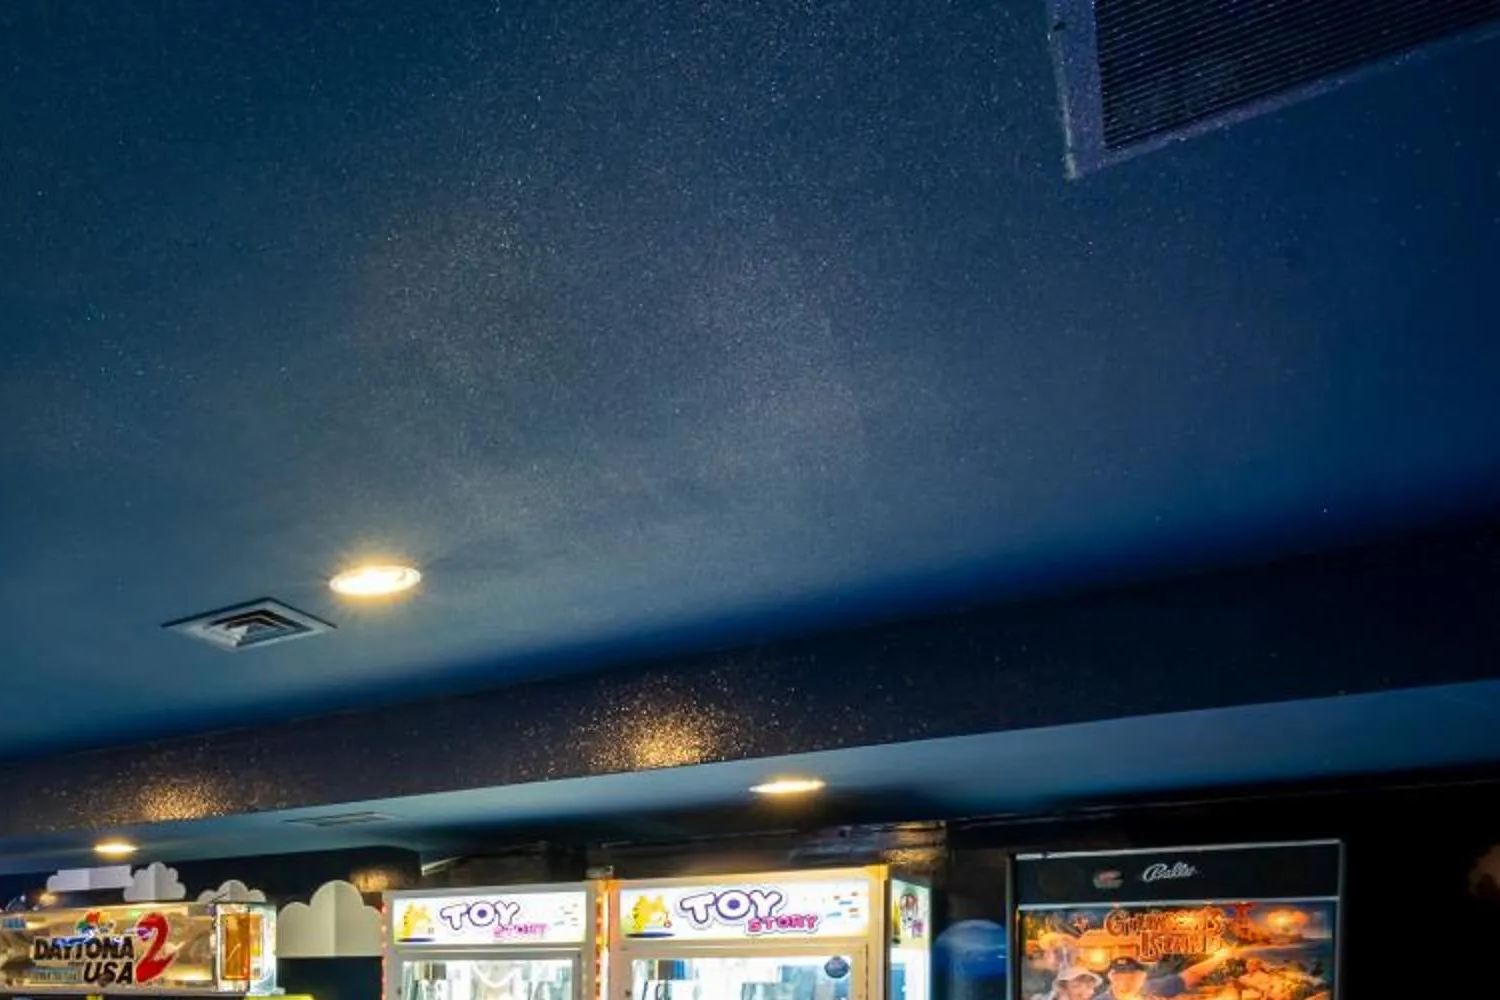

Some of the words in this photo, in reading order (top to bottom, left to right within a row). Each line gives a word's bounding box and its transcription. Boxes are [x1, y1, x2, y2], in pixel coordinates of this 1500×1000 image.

[439, 900, 521, 931] TOY
[679, 887, 783, 925] TOY
[746, 913, 820, 934] STORY
[33, 936, 136, 962] DAYTONA
[134, 911, 179, 985] 2
[83, 960, 134, 985] USA
